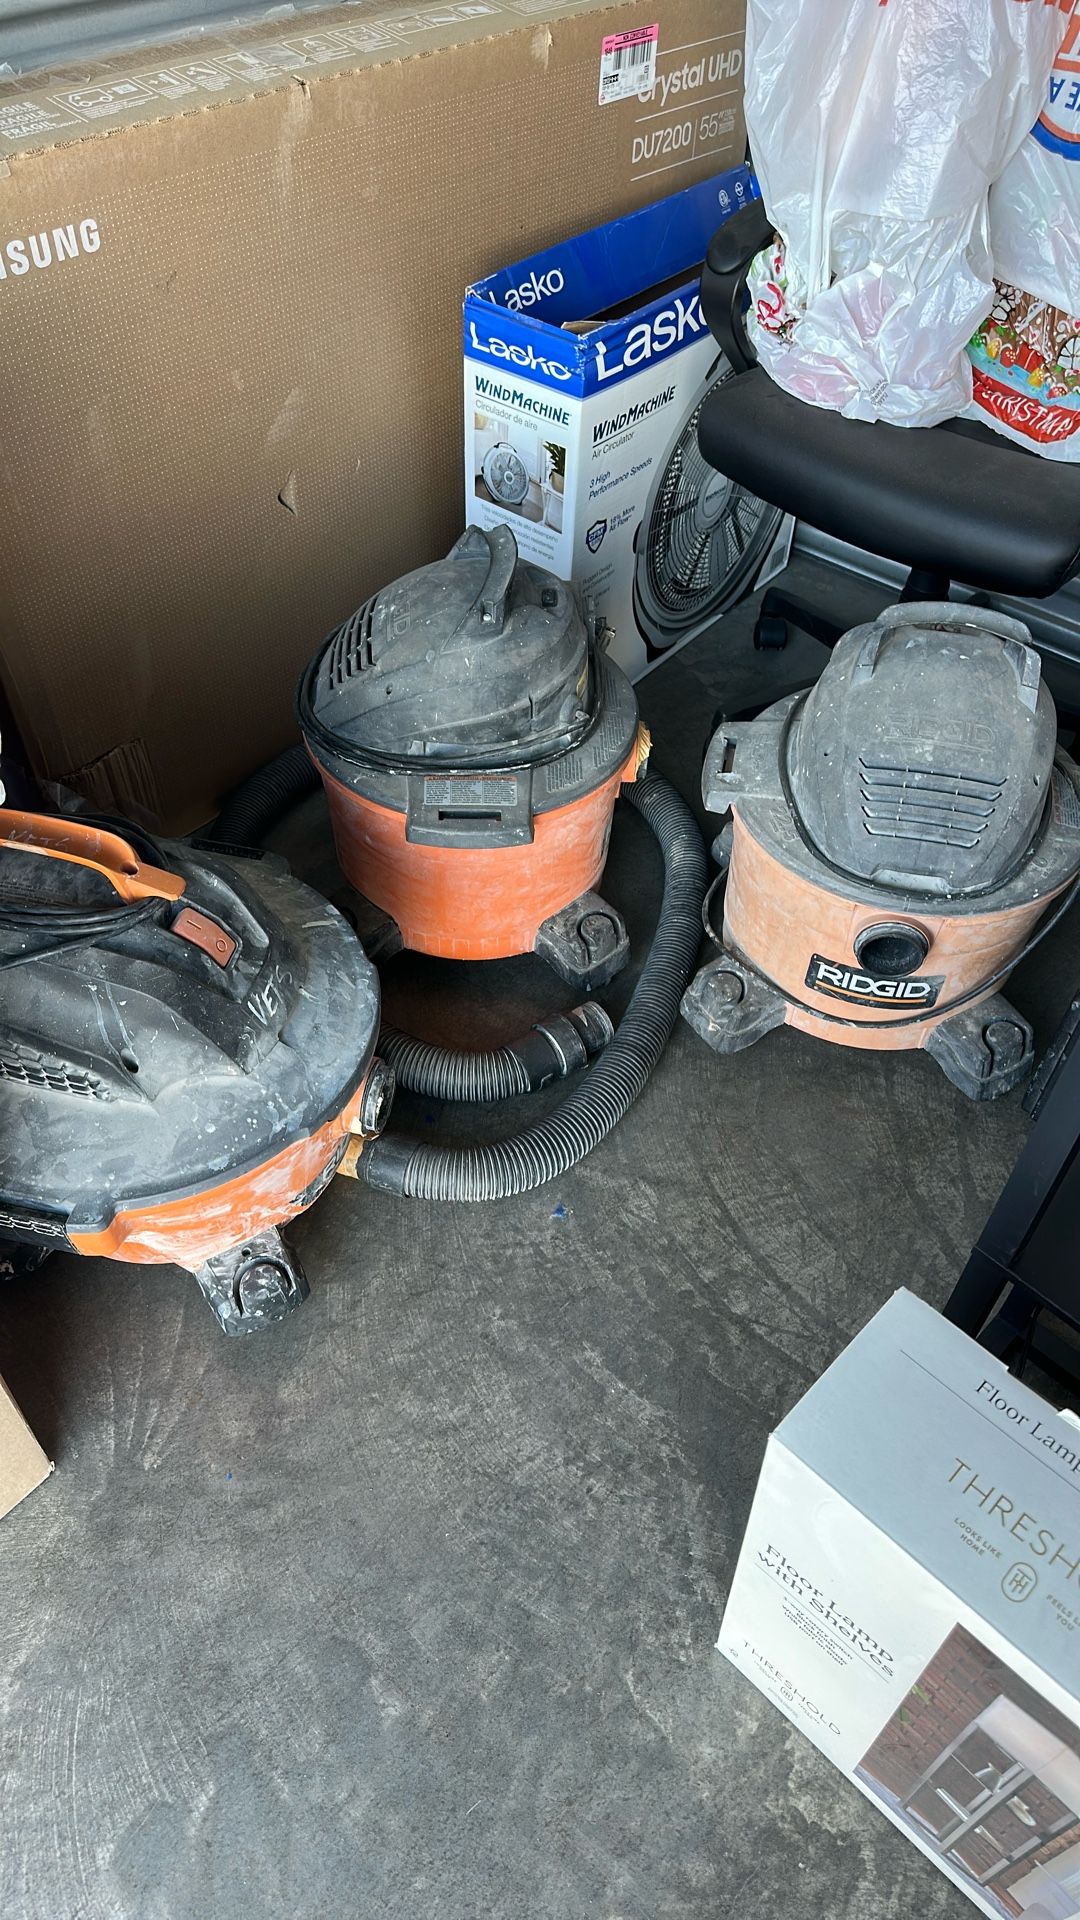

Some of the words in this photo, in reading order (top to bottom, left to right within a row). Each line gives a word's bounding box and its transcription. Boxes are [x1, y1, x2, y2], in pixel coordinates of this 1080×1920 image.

[707, 49, 743, 82] UHD
[631, 121, 693, 164] DU7200
[699, 112, 719, 141] 55
[469, 321, 572, 381] Lasko
[475, 400, 512, 420] Circulador
[513, 415, 523, 426] de
[524, 420, 538, 431] aire
[592, 449, 602, 461] Air
[603, 431, 634, 454] Circulator
[589, 471, 629, 500] Performance
[630, 457, 653, 476] Speeds
[590, 479, 595, 489] 3
[595, 471, 611, 484] High
[815, 961, 931, 998] RIDGID
[975, 1380, 1030, 1425] Floor
[949, 1458, 1080, 1588] THRESH
[954, 1517, 982, 1543] LOOKS
[982, 1540, 1002, 1560] LIKE
[960, 1533, 985, 1556] HOME
[766, 1544, 823, 1597] Floor
[828, 1600, 894, 1662] Lamp
[809, 1597, 894, 1677] Shelves
[744, 1639, 840, 1735] THRESHOLD
